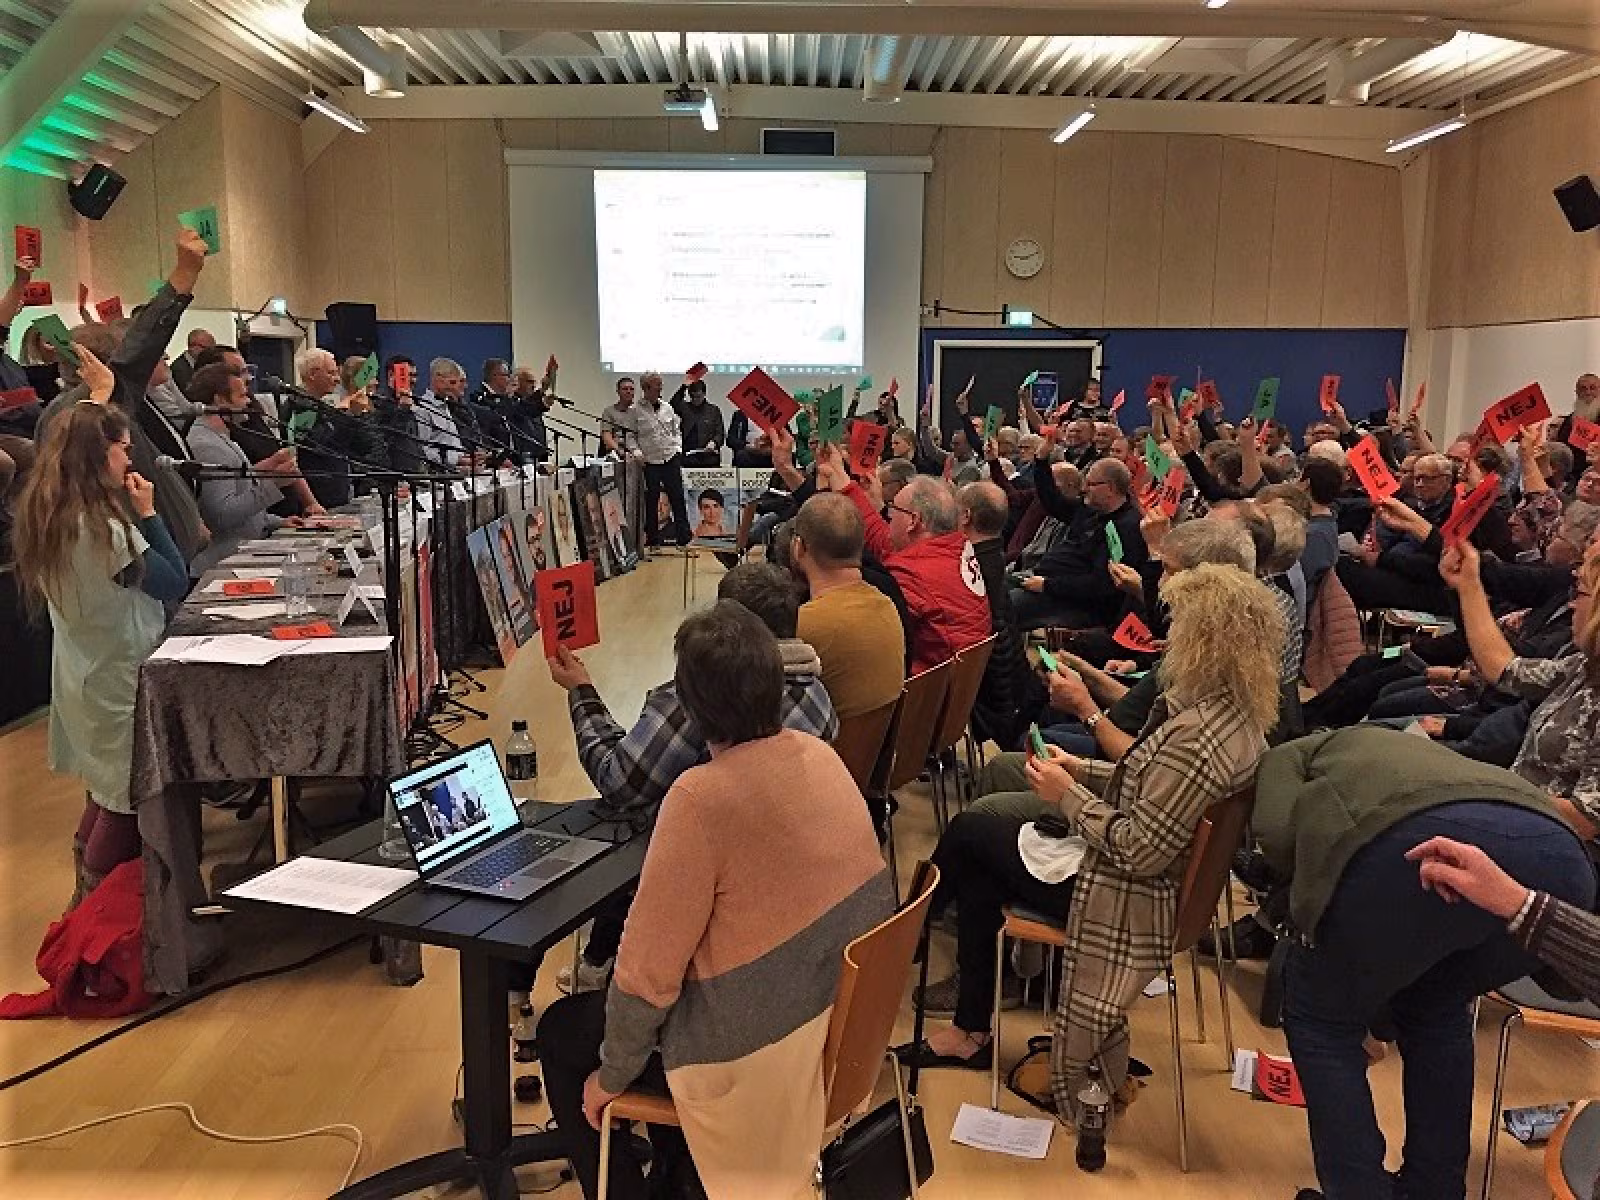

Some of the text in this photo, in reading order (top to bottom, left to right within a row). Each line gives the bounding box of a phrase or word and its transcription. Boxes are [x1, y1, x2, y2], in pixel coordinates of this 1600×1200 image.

[741, 386, 783, 425] NEJ
[827, 405, 840, 431] JA
[1495, 393, 1538, 426] NEJ
[858, 432, 881, 470] NEJ
[1361, 447, 1389, 489] NEJ
[551, 579, 577, 641] NEJ
[1267, 1063, 1291, 1099] NEJ
